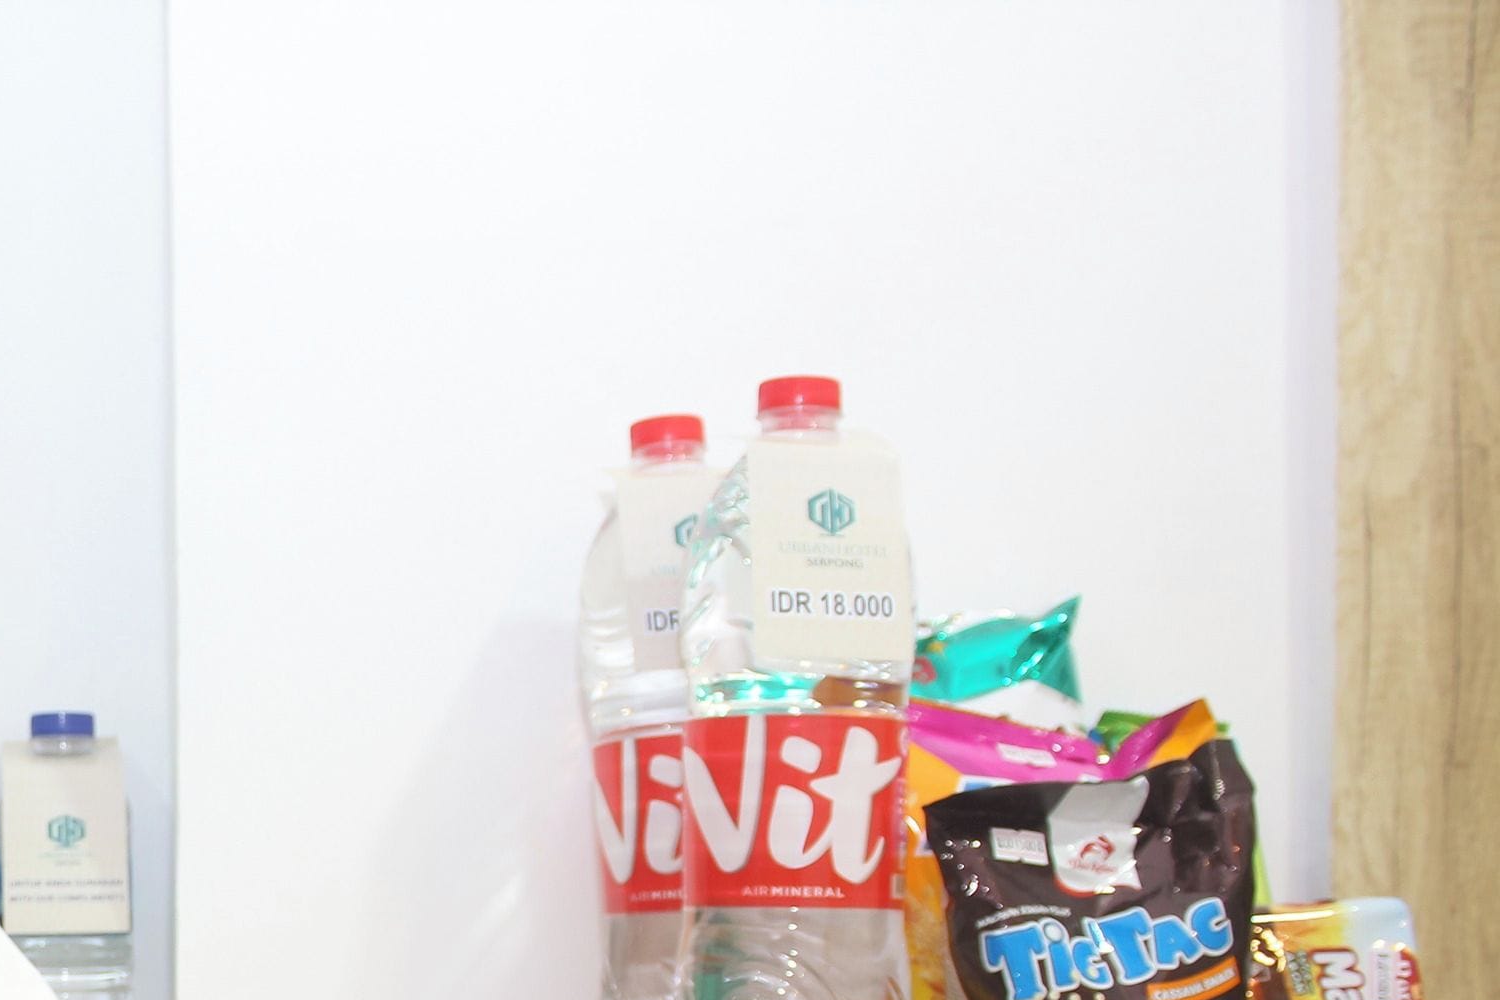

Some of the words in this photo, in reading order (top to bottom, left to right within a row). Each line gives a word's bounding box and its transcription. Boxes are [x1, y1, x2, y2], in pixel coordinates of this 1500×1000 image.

[771, 590, 811, 614] IDR
[820, 592, 893, 618] 18.000
[594, 737, 683, 885] Vi
[683, 715, 902, 884] Vit
[771, 887, 846, 898] MINERAL
